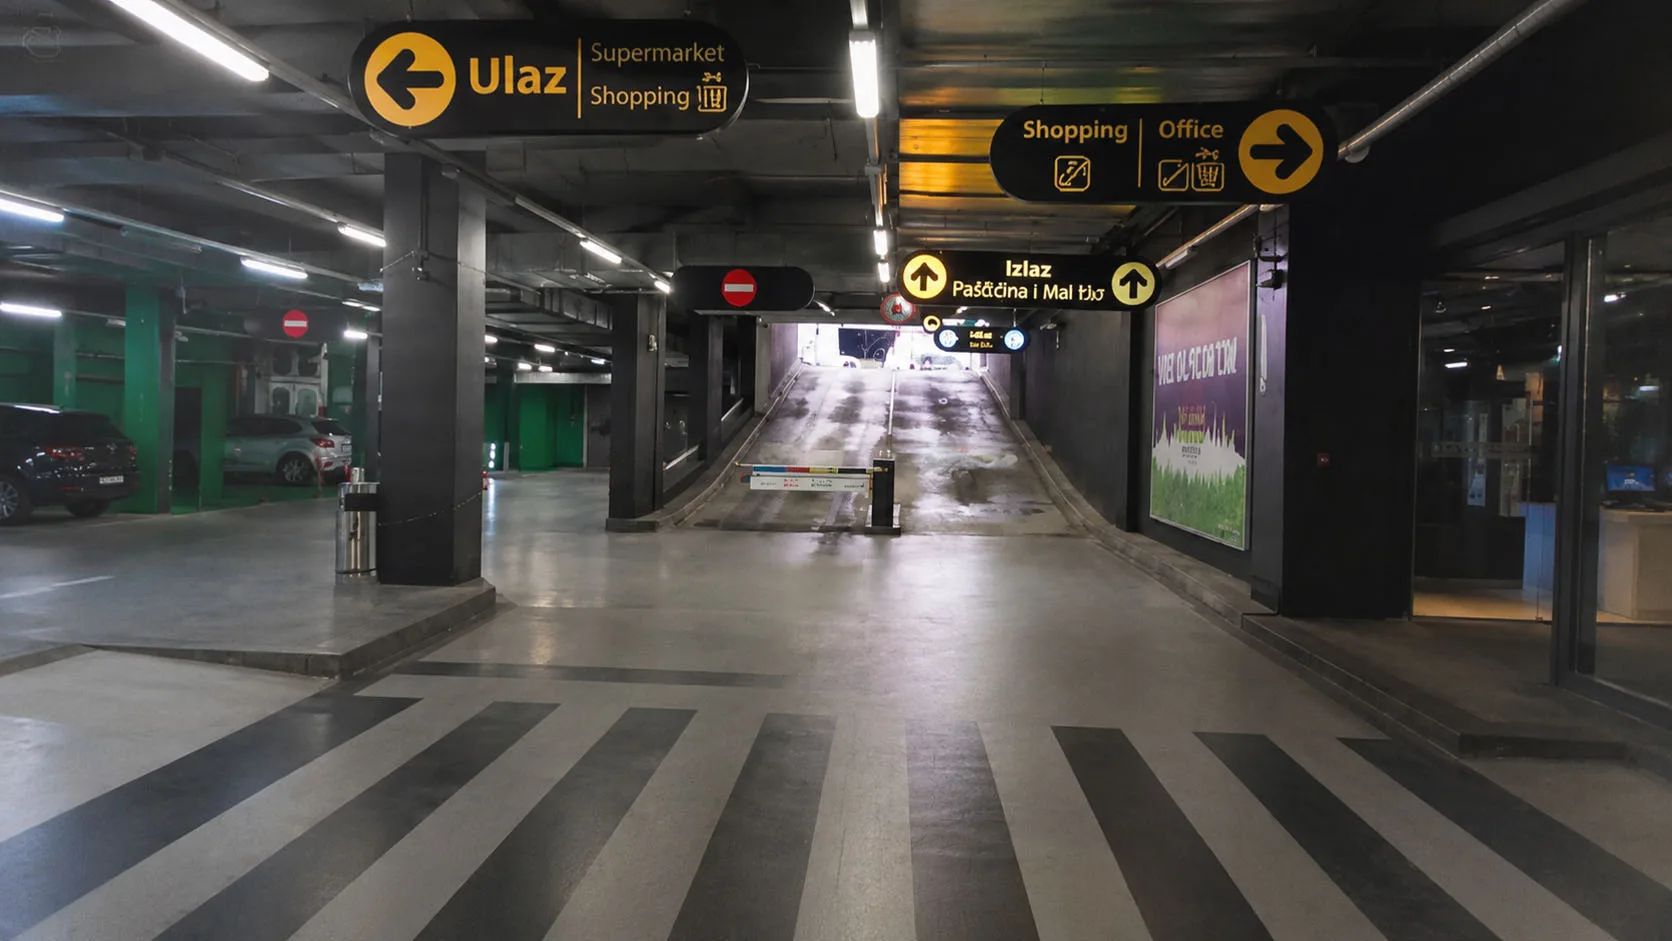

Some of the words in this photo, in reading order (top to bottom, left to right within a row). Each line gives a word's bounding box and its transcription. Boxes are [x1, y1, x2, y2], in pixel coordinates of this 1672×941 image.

[591, 43, 725, 67] Supermarket
[469, 55, 567, 94] Ulaz
[590, 85, 690, 110] Shopping
[1023, 120, 1128, 144] Shopping
[1159, 120, 1224, 139] Office
[1005, 260, 1052, 278] Izlaz
[1033, 284, 1038, 300] i
[1042, 284, 1073, 301] Mal
